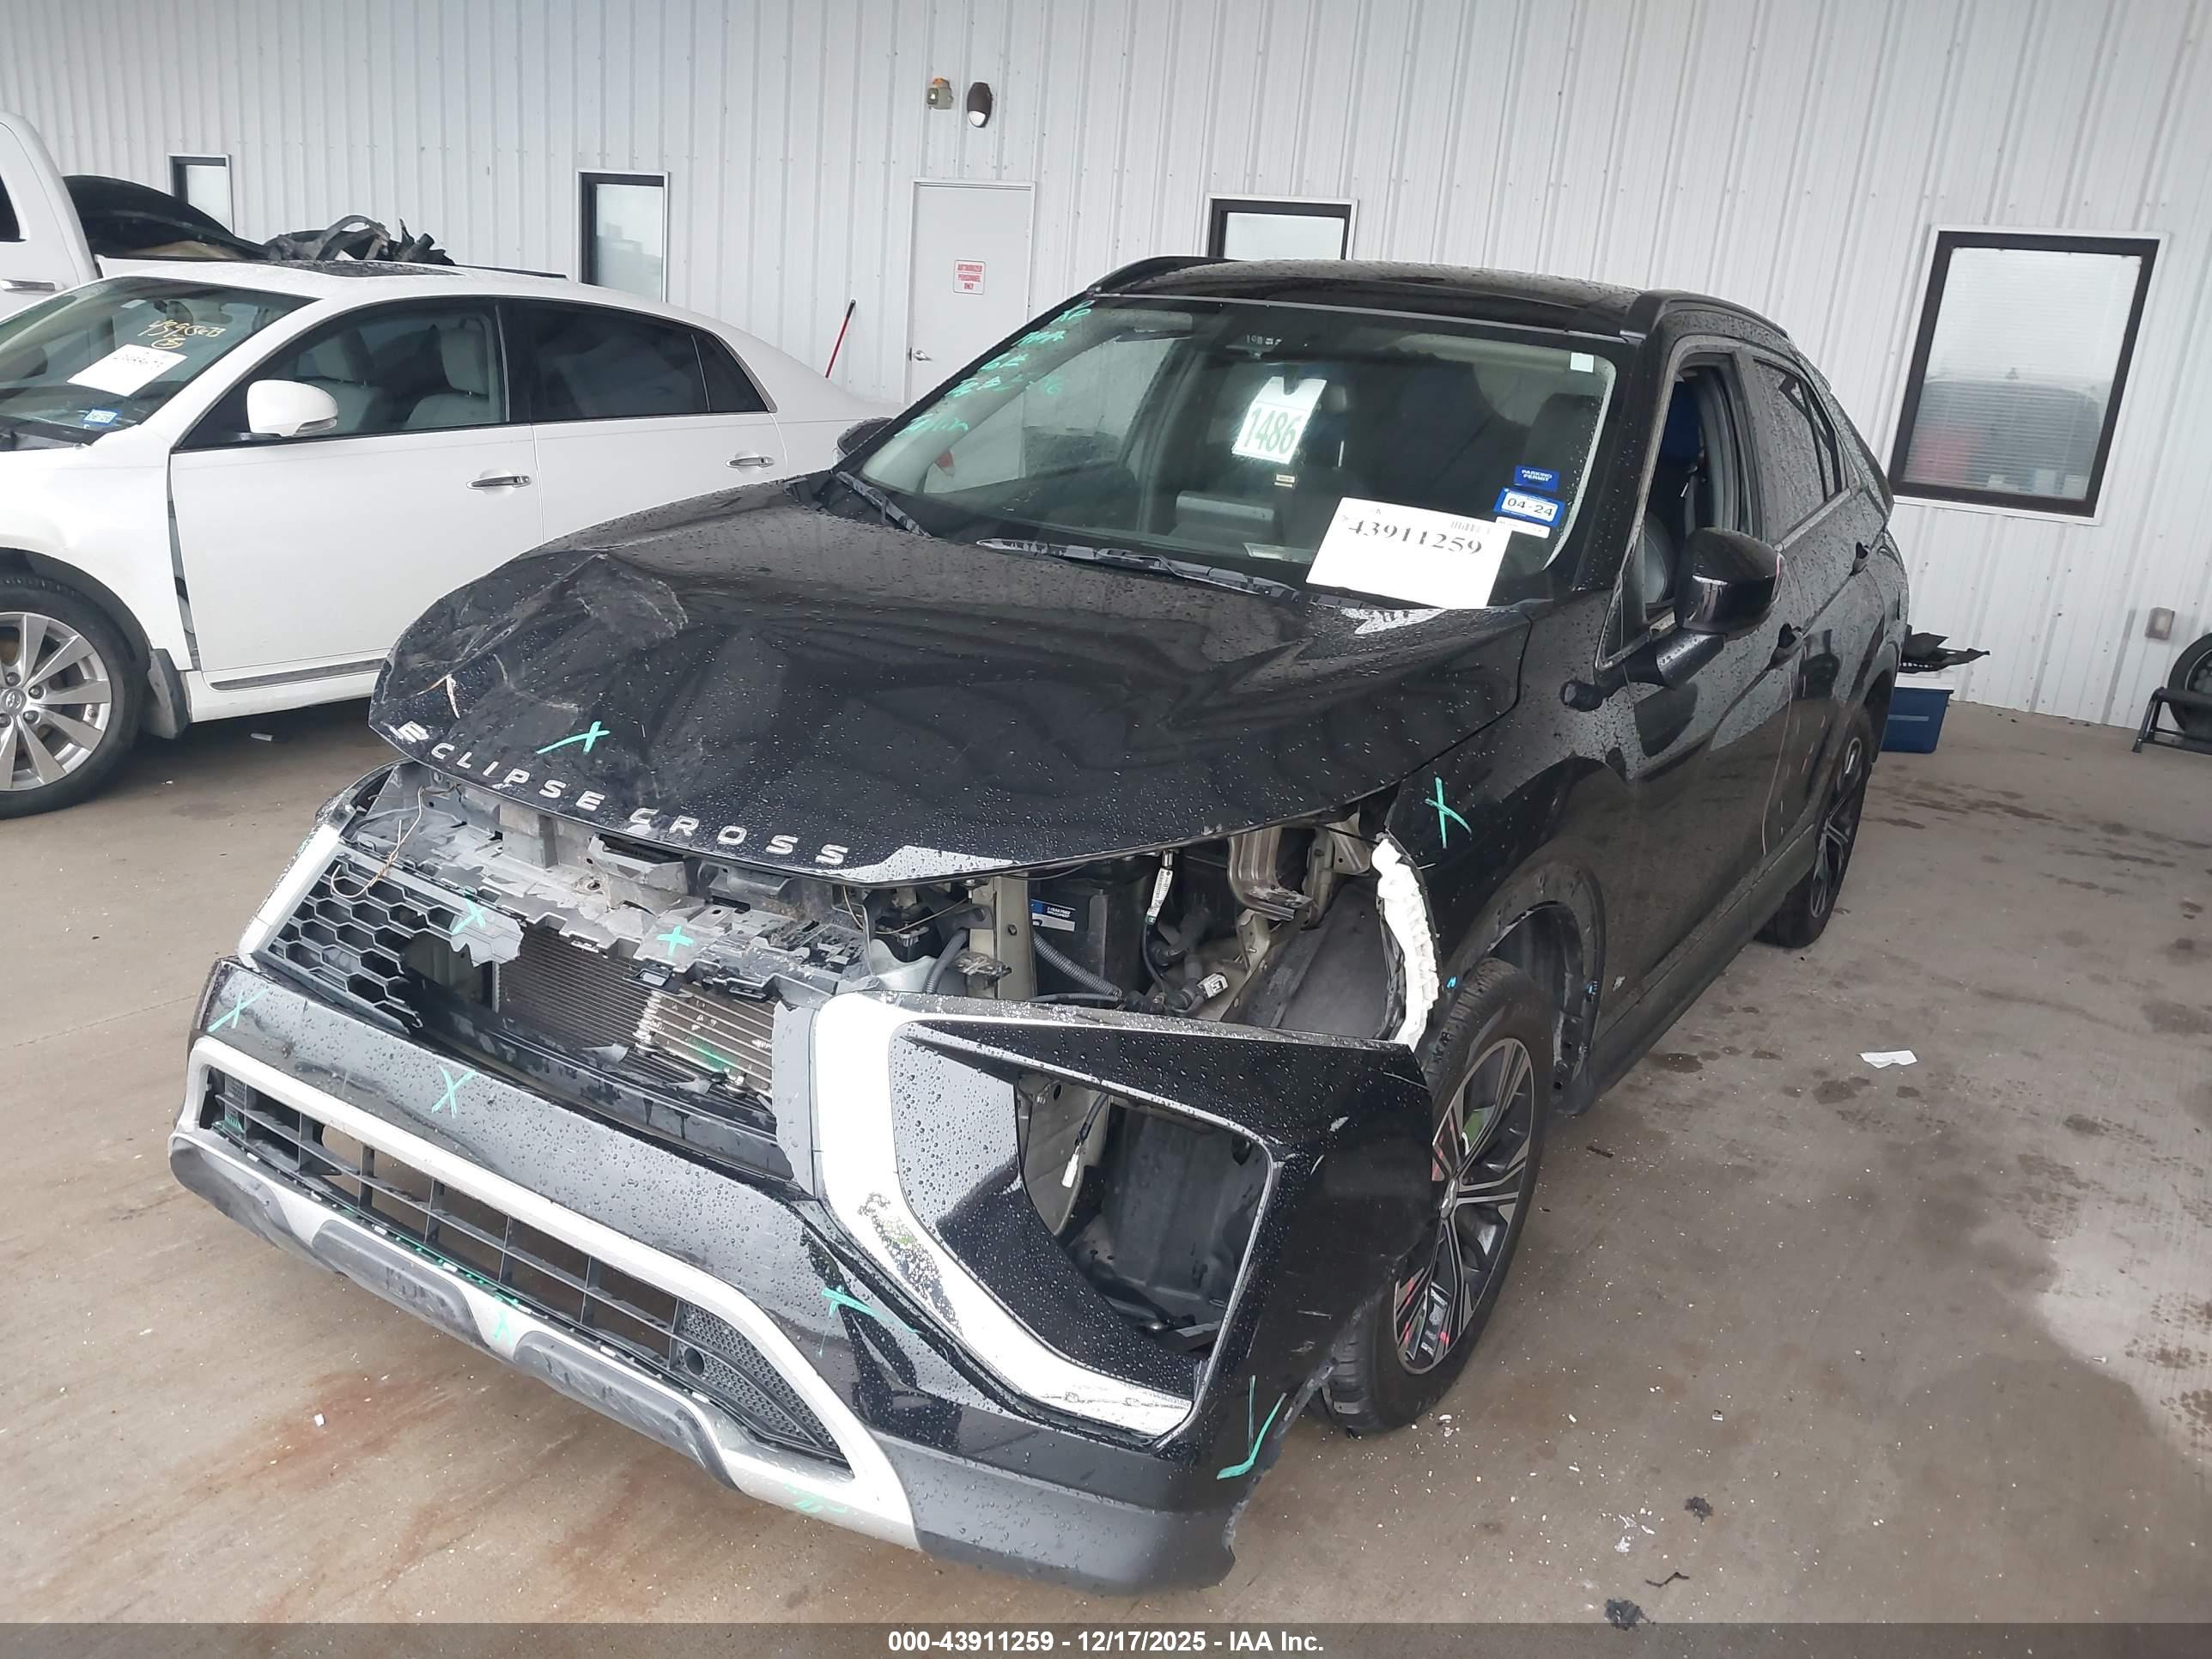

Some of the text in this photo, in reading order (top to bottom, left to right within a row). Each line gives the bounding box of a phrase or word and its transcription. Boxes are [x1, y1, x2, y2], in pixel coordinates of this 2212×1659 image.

[1244, 406, 1304, 455] 1486
[1521, 469, 1553, 479] PARKING
[1507, 497, 1553, 517] 04-24
[1348, 520, 1483, 555] 43911259
[397, 720, 849, 866] ECLIPSE CROSS
